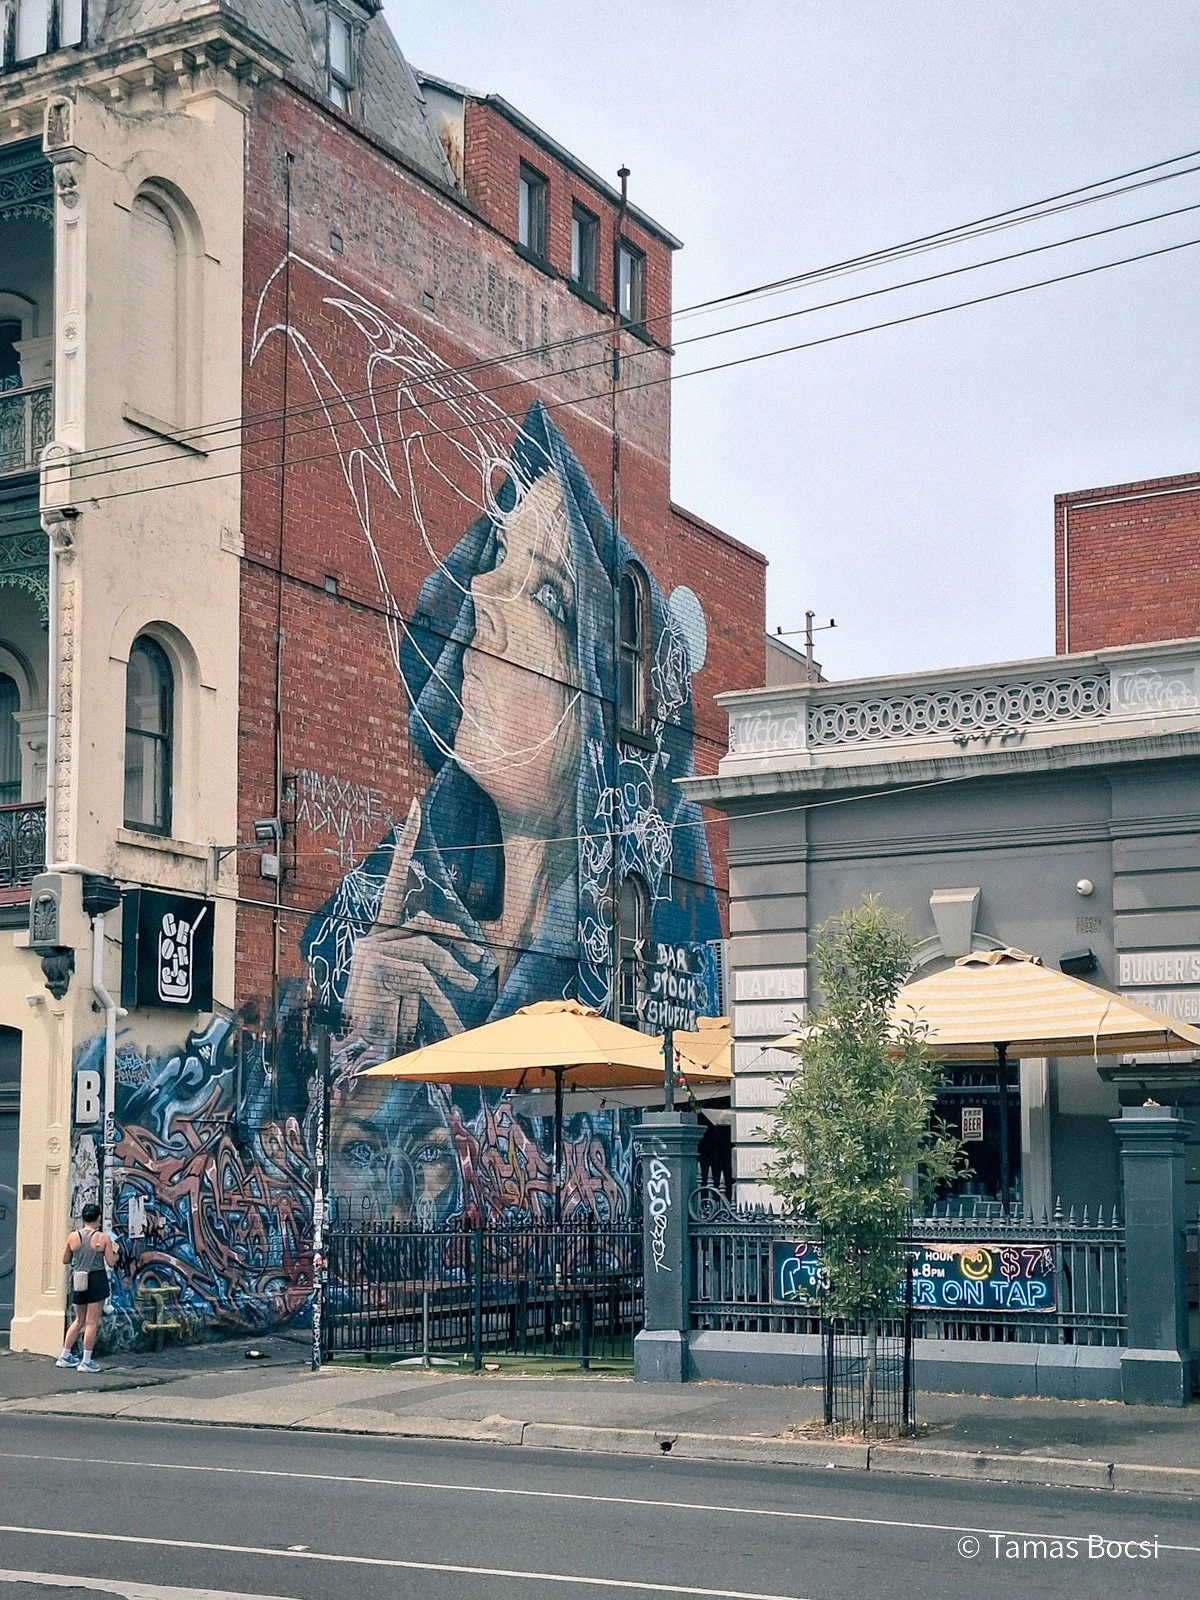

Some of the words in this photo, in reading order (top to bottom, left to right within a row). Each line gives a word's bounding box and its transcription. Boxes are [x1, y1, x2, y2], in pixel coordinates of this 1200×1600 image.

[656, 943, 688, 971] BAR
[650, 967, 696, 1002] STOCK
[739, 974, 802, 997] TAPAS
[963, 1117, 982, 1132] BEER
[925, 1251, 954, 1262] HOUR
[1000, 1247, 1043, 1283] $7
[942, 1279, 984, 1305] ON
[989, 1280, 1047, 1307] TAP
